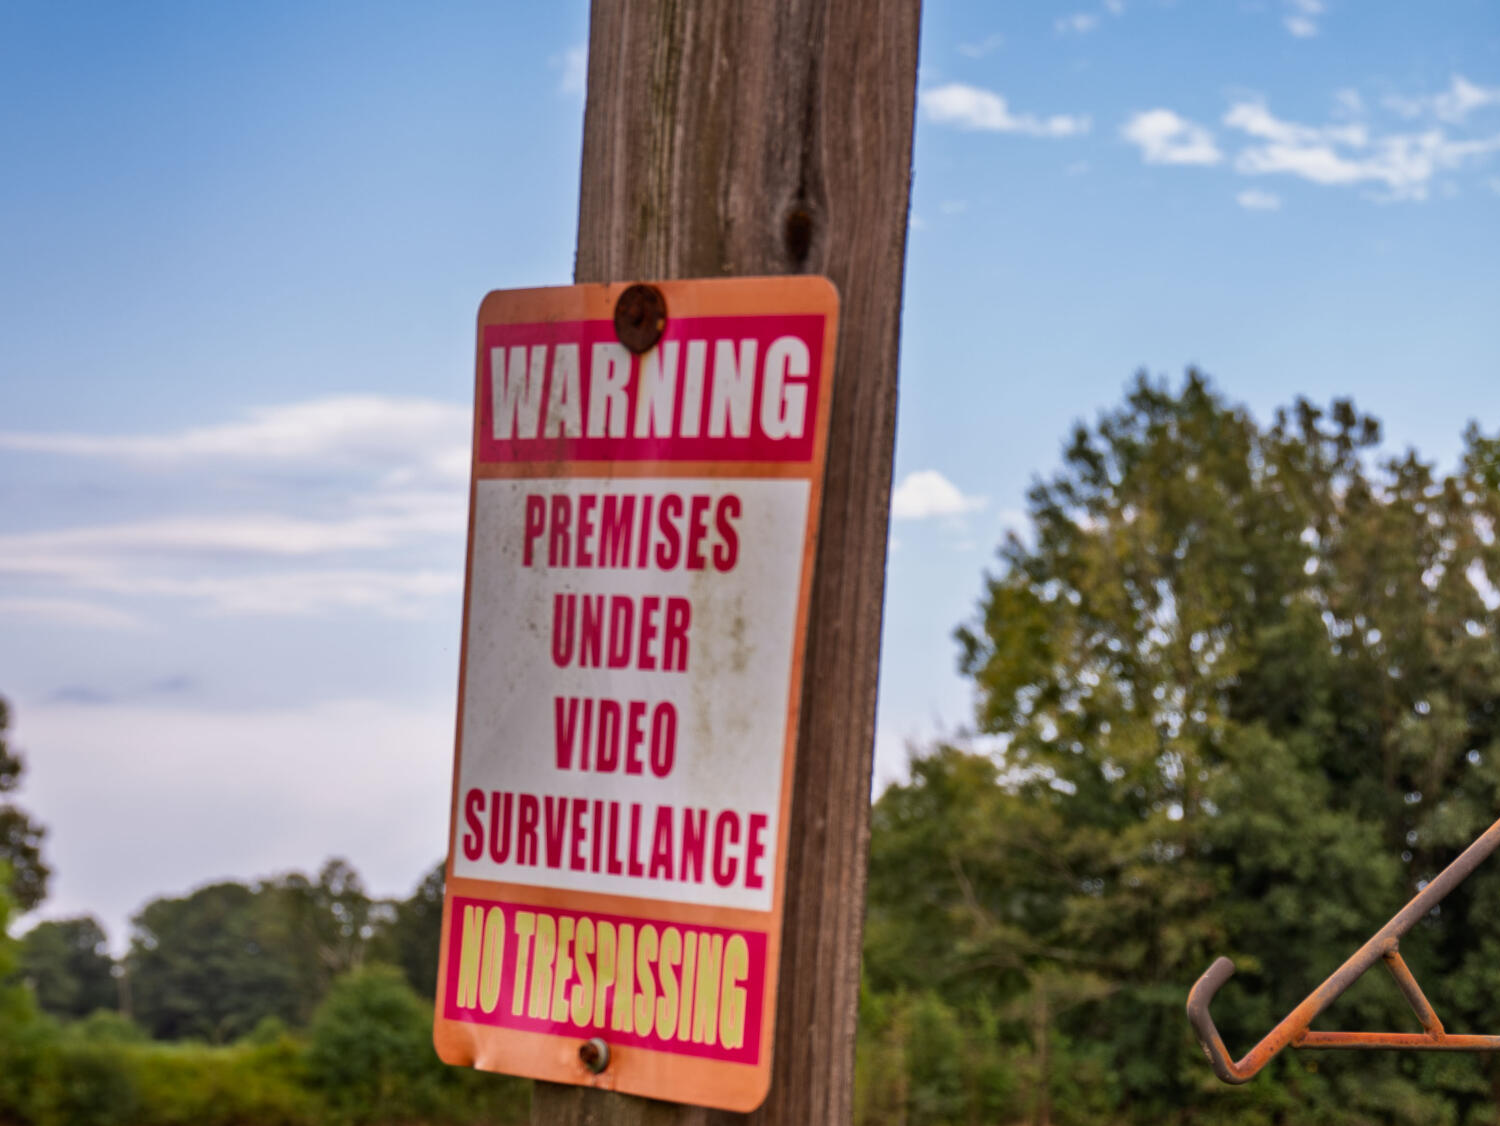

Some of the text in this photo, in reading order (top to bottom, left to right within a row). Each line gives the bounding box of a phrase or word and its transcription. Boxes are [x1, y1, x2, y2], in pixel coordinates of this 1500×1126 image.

[490, 336, 811, 441] WARNING
[522, 493, 743, 573] PREMISES
[550, 593, 692, 673] UNDER
[554, 697, 679, 778] VIDEO
[462, 788, 769, 891] SURVEILLANCE
[456, 905, 749, 1050] NO TRESPASSING
